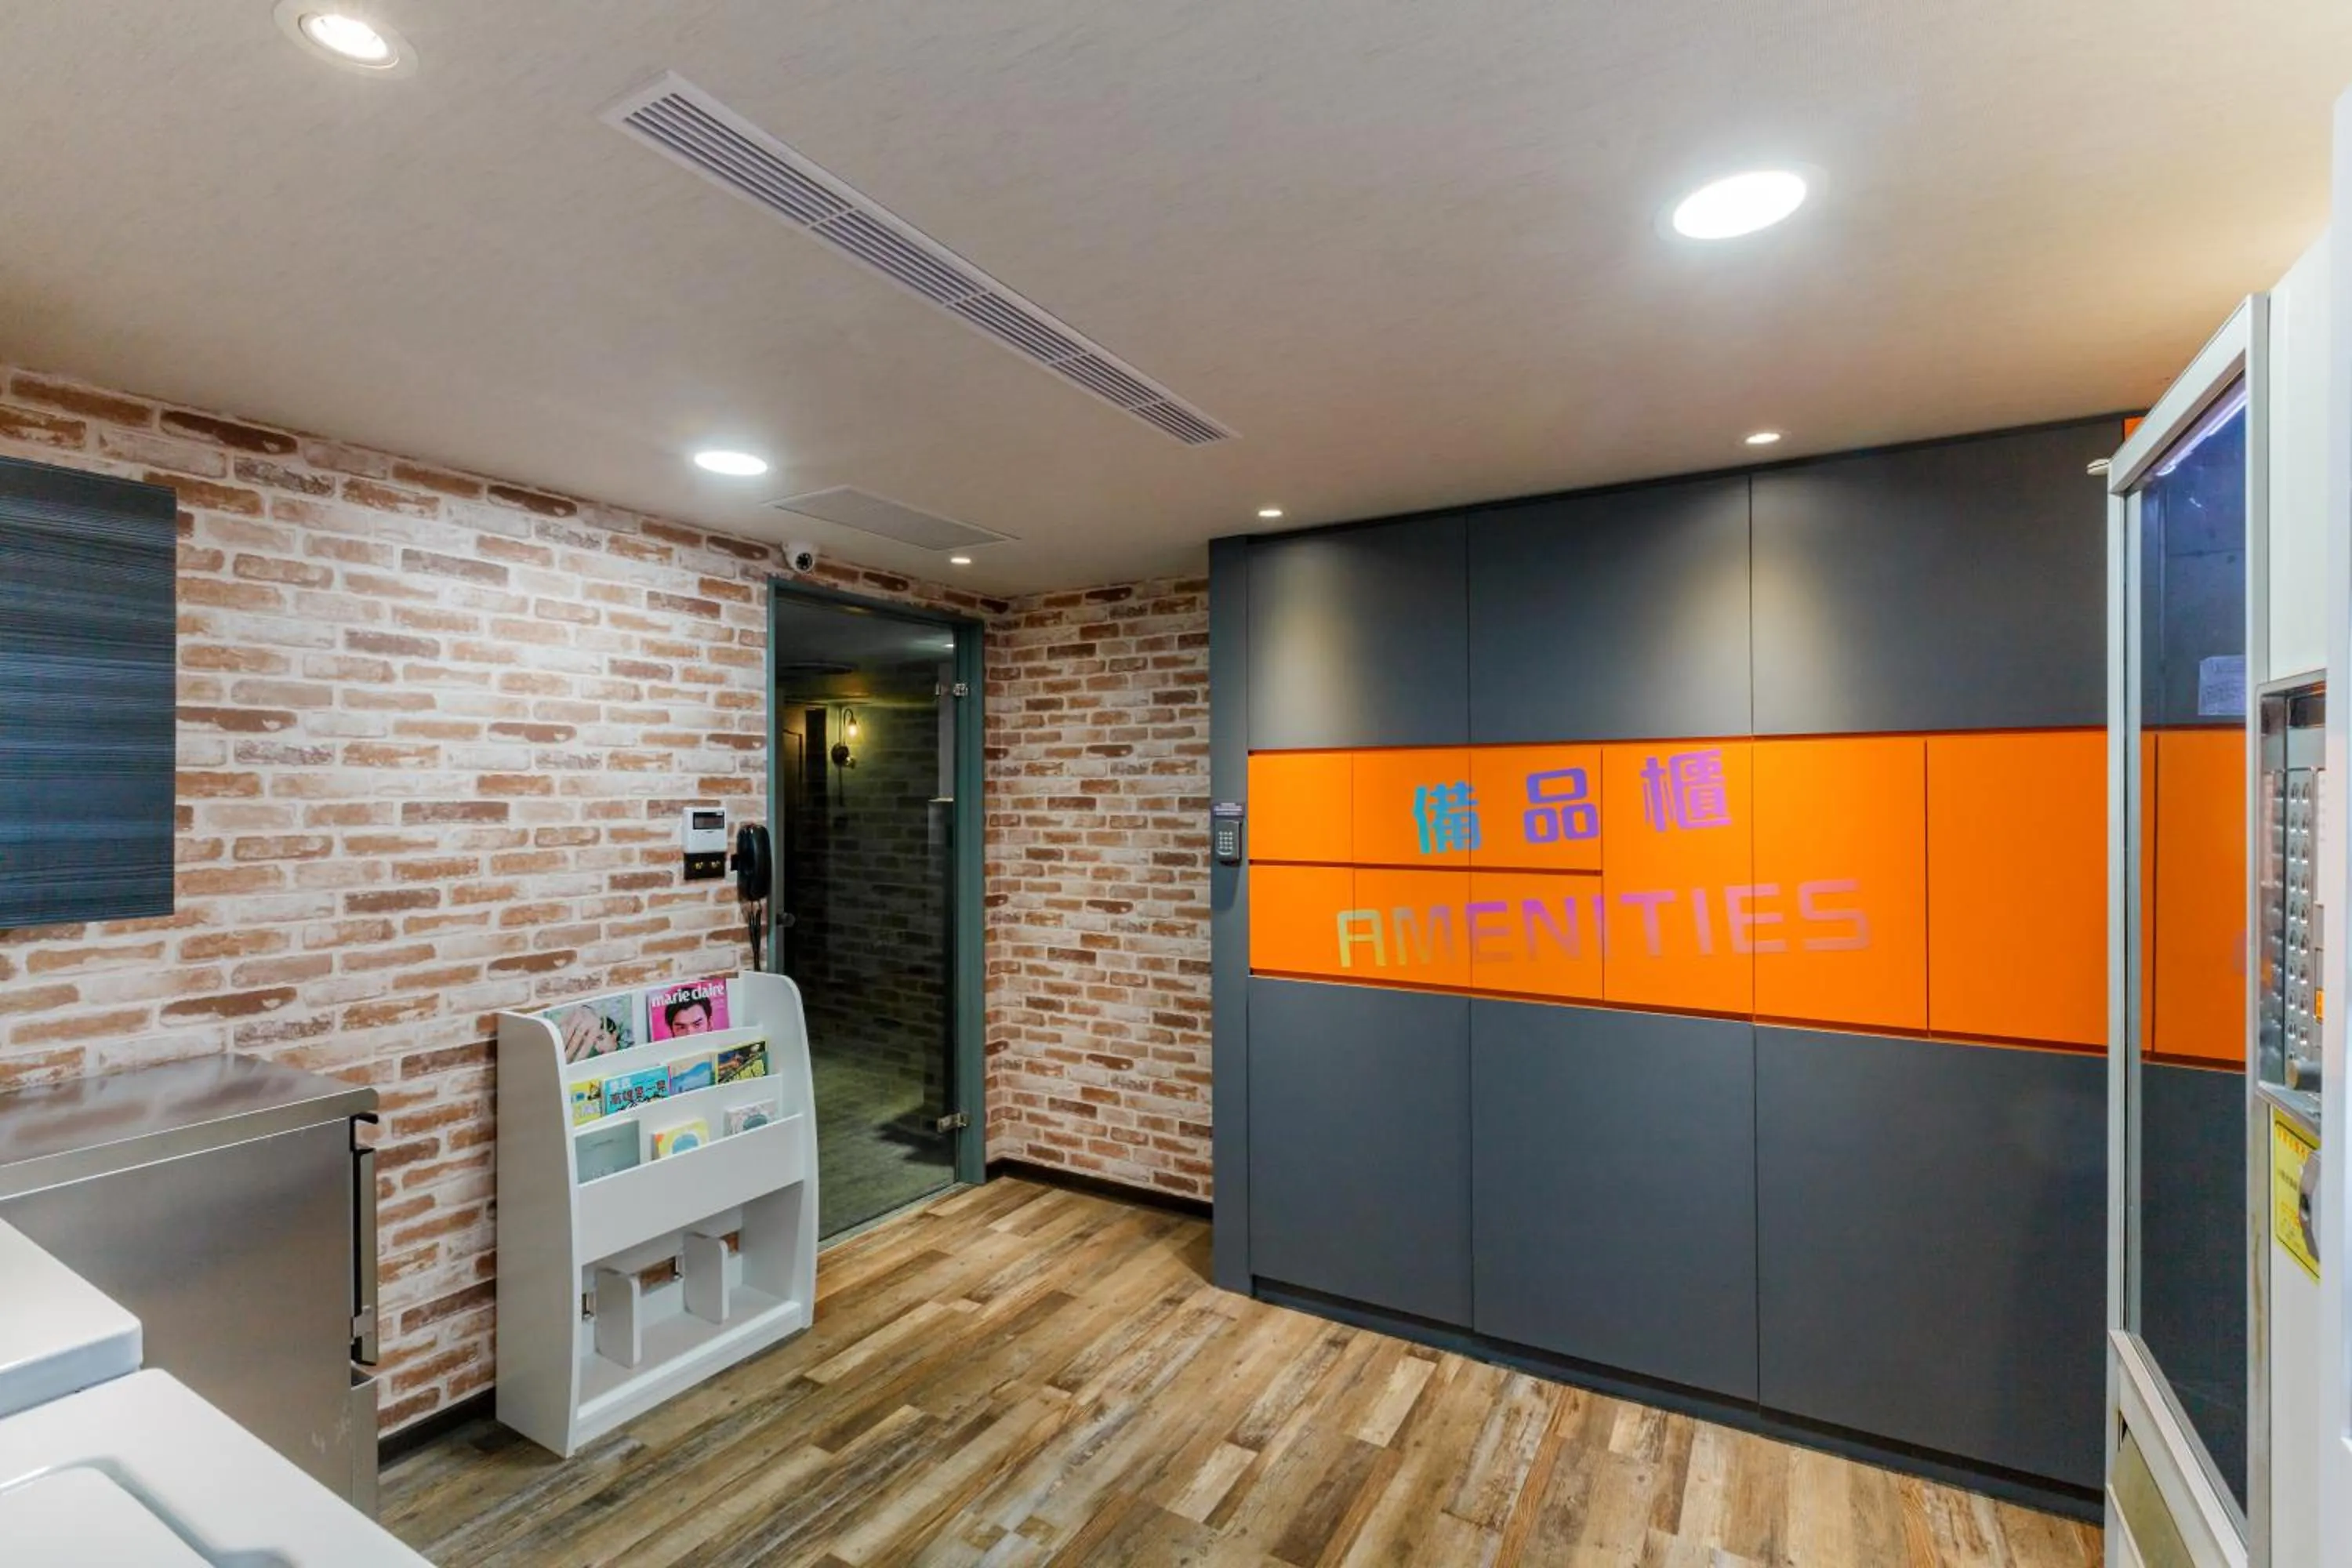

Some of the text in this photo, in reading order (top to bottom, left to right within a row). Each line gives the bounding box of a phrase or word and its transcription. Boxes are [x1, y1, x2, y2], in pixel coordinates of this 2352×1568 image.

[1412, 748, 1733, 854] 備品櫃
[1336, 877, 1872, 968] AMENITIES
[651, 988, 690, 1007] marie
[691, 982, 724, 1000] claire
